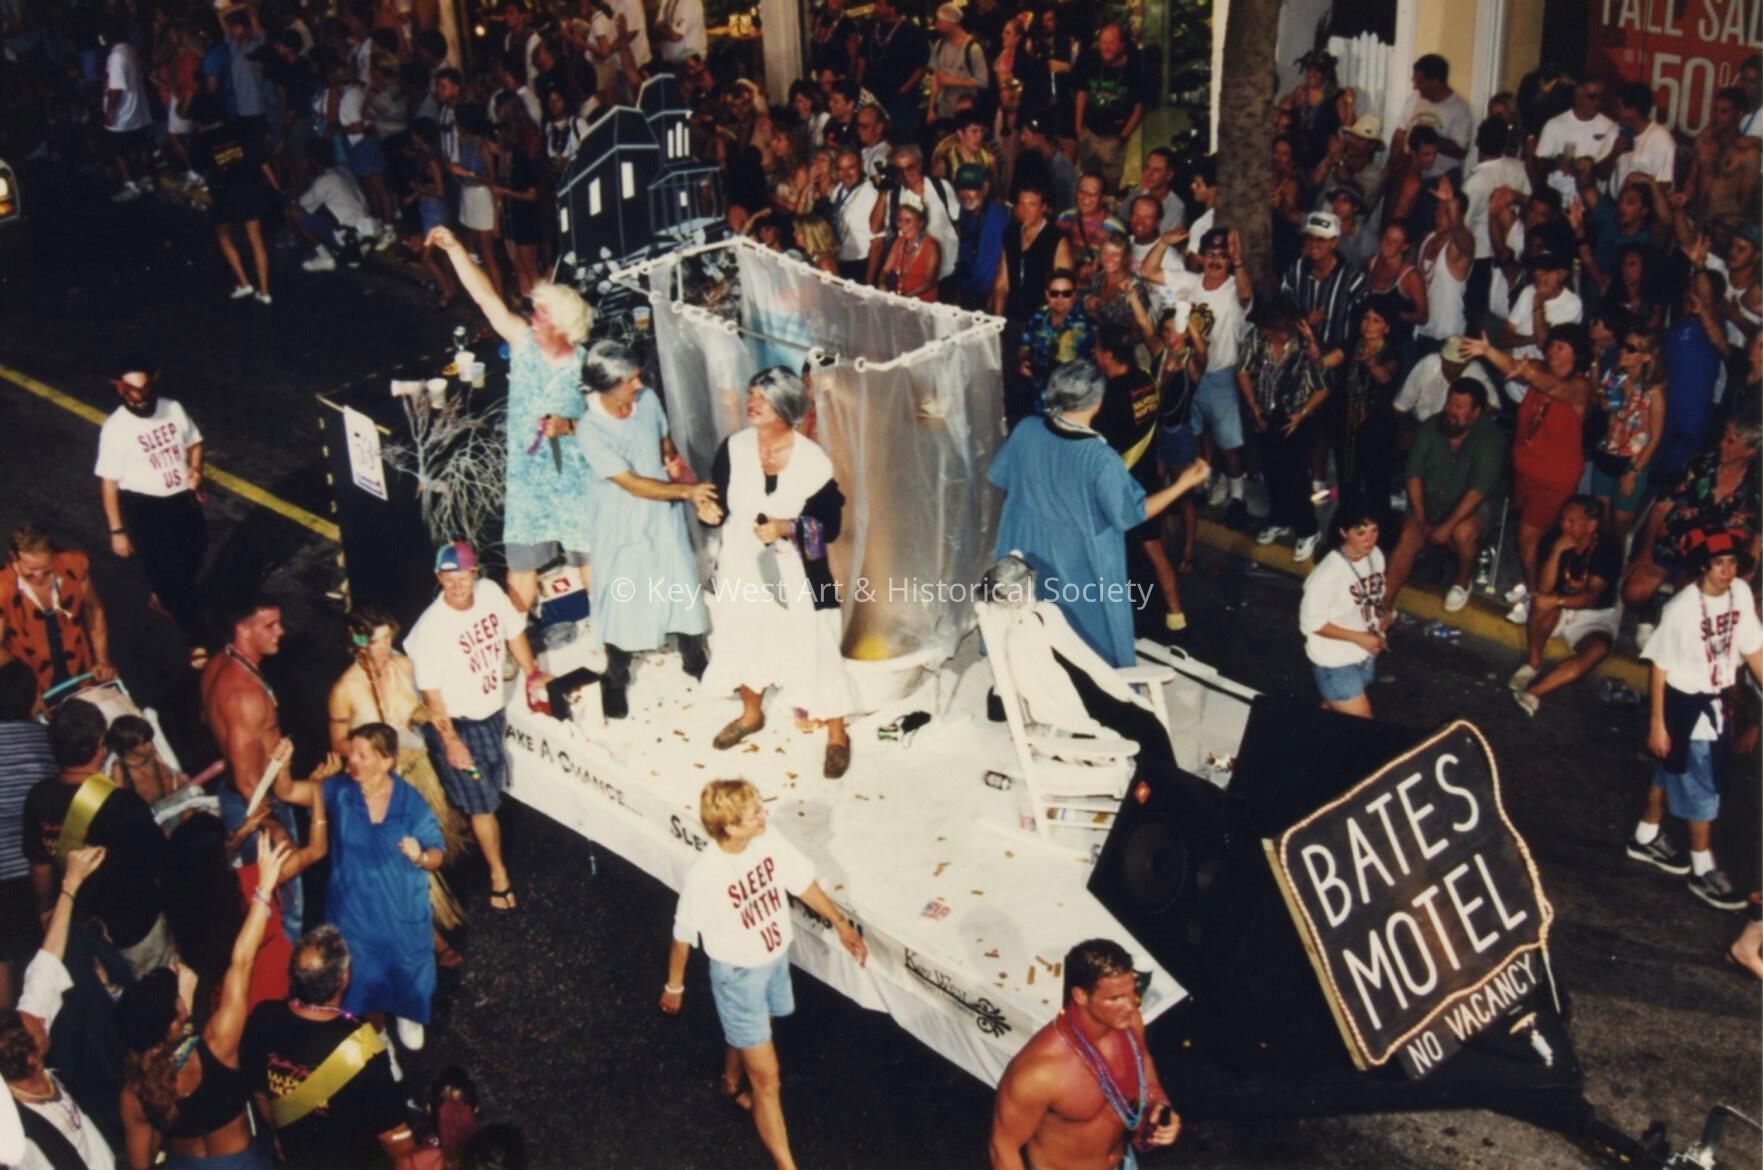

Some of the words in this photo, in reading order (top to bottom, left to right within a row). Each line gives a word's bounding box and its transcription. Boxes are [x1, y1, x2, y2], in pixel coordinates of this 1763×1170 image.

[138, 422, 177, 453] SLEEP
[149, 445, 181, 470] WITH
[163, 468, 182, 489] US
[459, 613, 499, 654] SLEEP
[483, 669, 498, 694] US
[506, 725, 534, 751] AKE
[541, 738, 554, 763] A
[670, 814, 708, 851] SLE
[1301, 753, 1479, 928] BATES
[728, 857, 775, 909] SLEEP
[741, 886, 782, 930] WITH
[760, 921, 782, 953] US
[1342, 853, 1527, 1030] MOTEL
[1407, 1031, 1443, 1075] NO
[1445, 952, 1537, 1041] VACANCY
